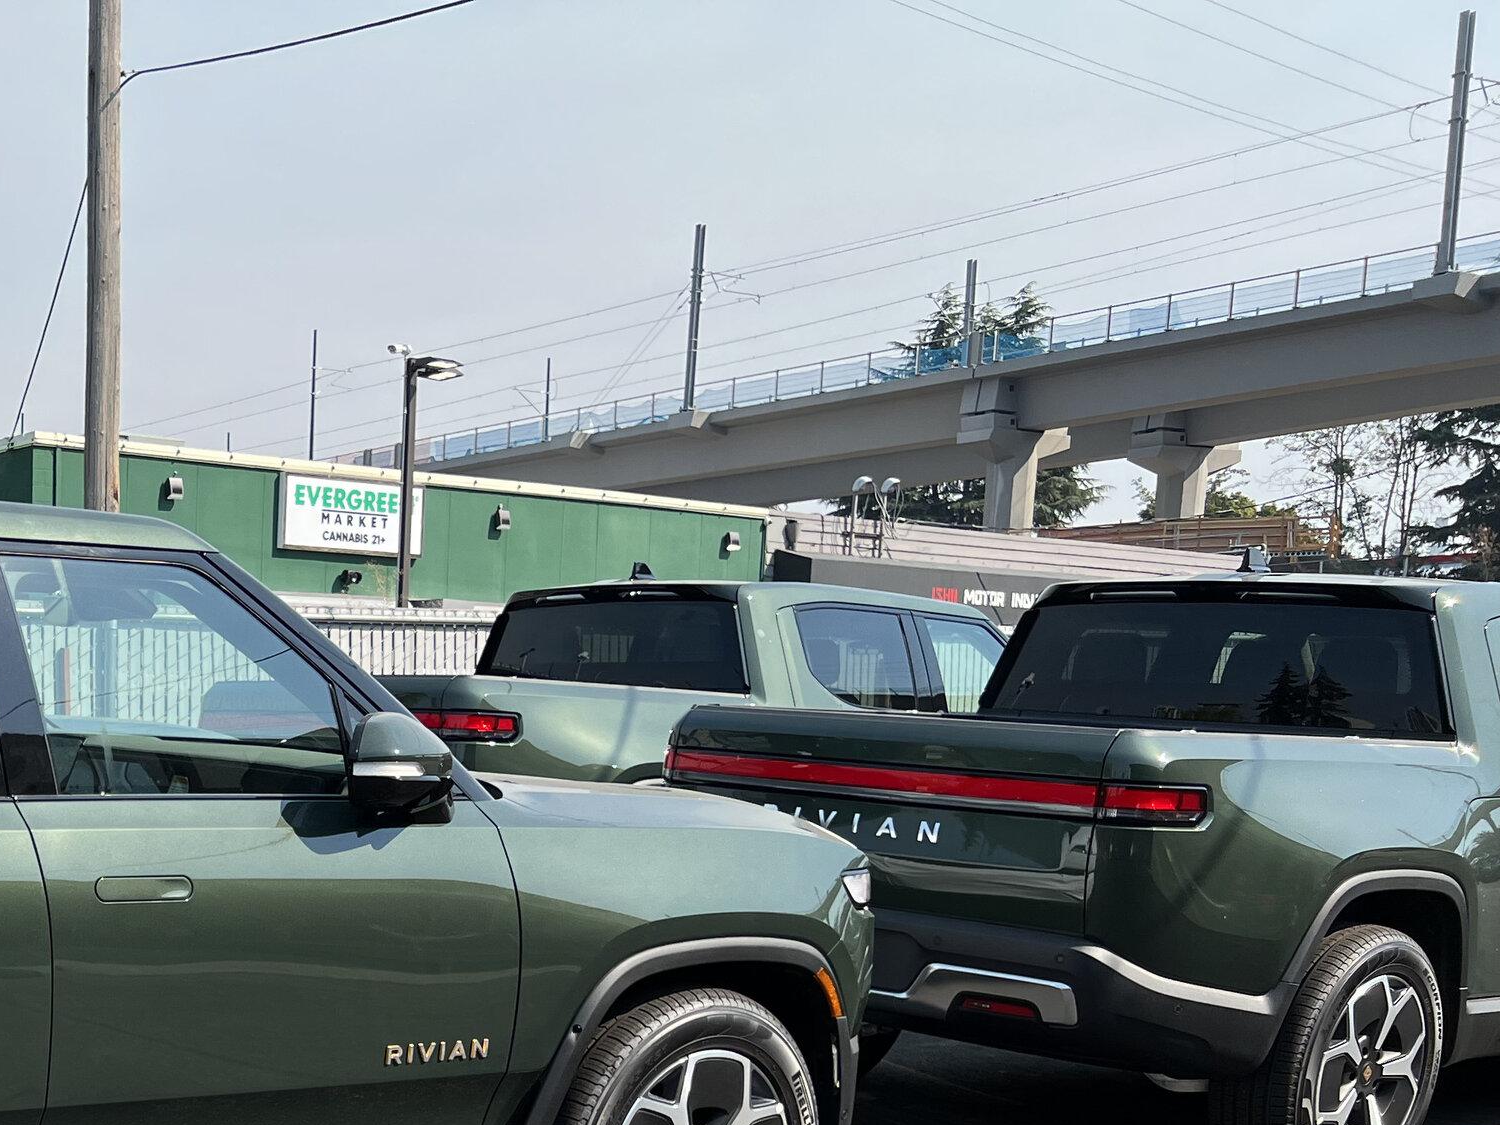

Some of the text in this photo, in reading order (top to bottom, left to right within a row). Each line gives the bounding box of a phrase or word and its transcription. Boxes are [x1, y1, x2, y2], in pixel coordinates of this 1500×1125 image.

[294, 484, 400, 514] EVERGREE
[321, 512, 388, 529] MARKET
[322, 531, 386, 545] CANNABIS 21+
[963, 589, 1005, 607] MOTOR
[385, 1038, 490, 1066] RIVIAN
